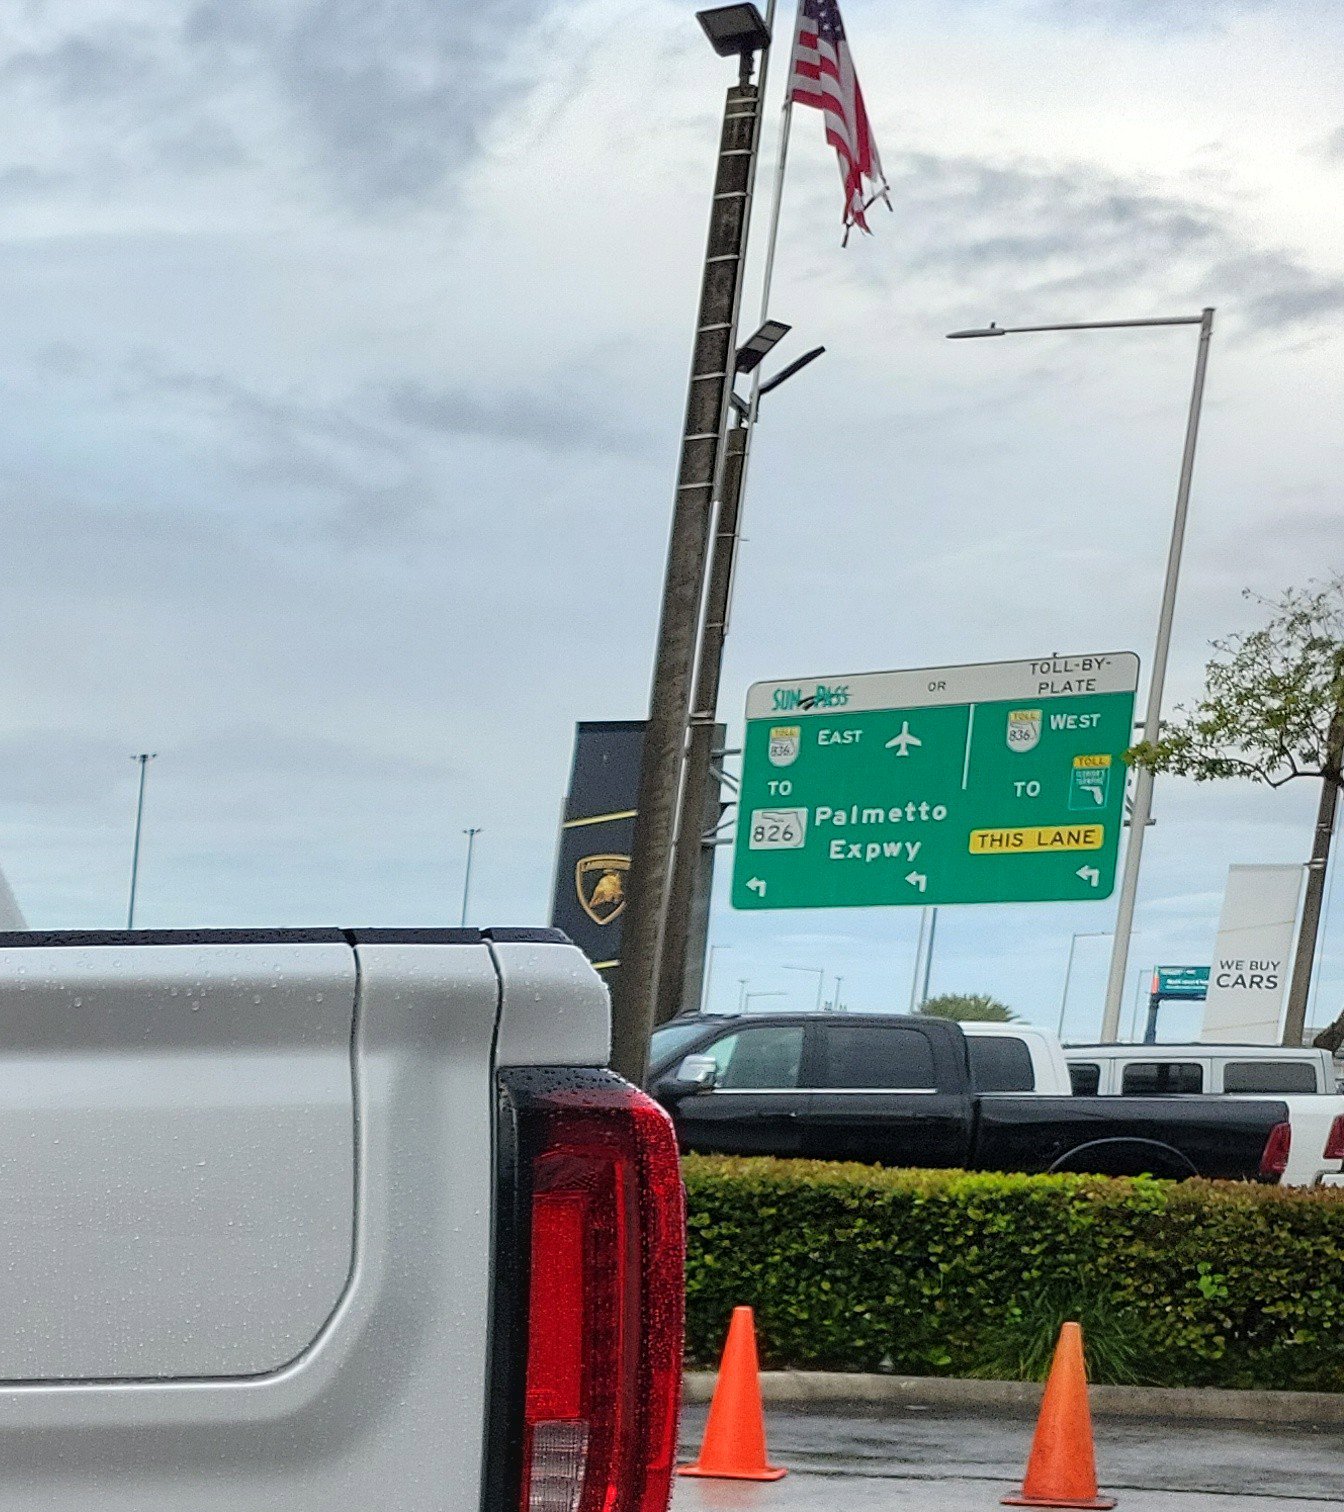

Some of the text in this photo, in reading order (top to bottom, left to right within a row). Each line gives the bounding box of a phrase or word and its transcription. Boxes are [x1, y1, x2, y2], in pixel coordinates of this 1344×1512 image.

[928, 681, 947, 692] OR
[1038, 678, 1097, 695] PLATE
[1050, 713, 1101, 731] WEST
[817, 729, 863, 746] EAST
[1009, 729, 1030, 742] 836
[1078, 755, 1105, 767] TOLL
[767, 780, 793, 796] TO
[1014, 781, 1041, 797] TO
[815, 801, 947, 826] Palmetto
[753, 825, 793, 843] 826
[978, 829, 1096, 848] THIS LANE
[830, 839, 922, 863] Expwy
[1219, 960, 1281, 971] WE BUY
[1216, 973, 1278, 989] CARS
